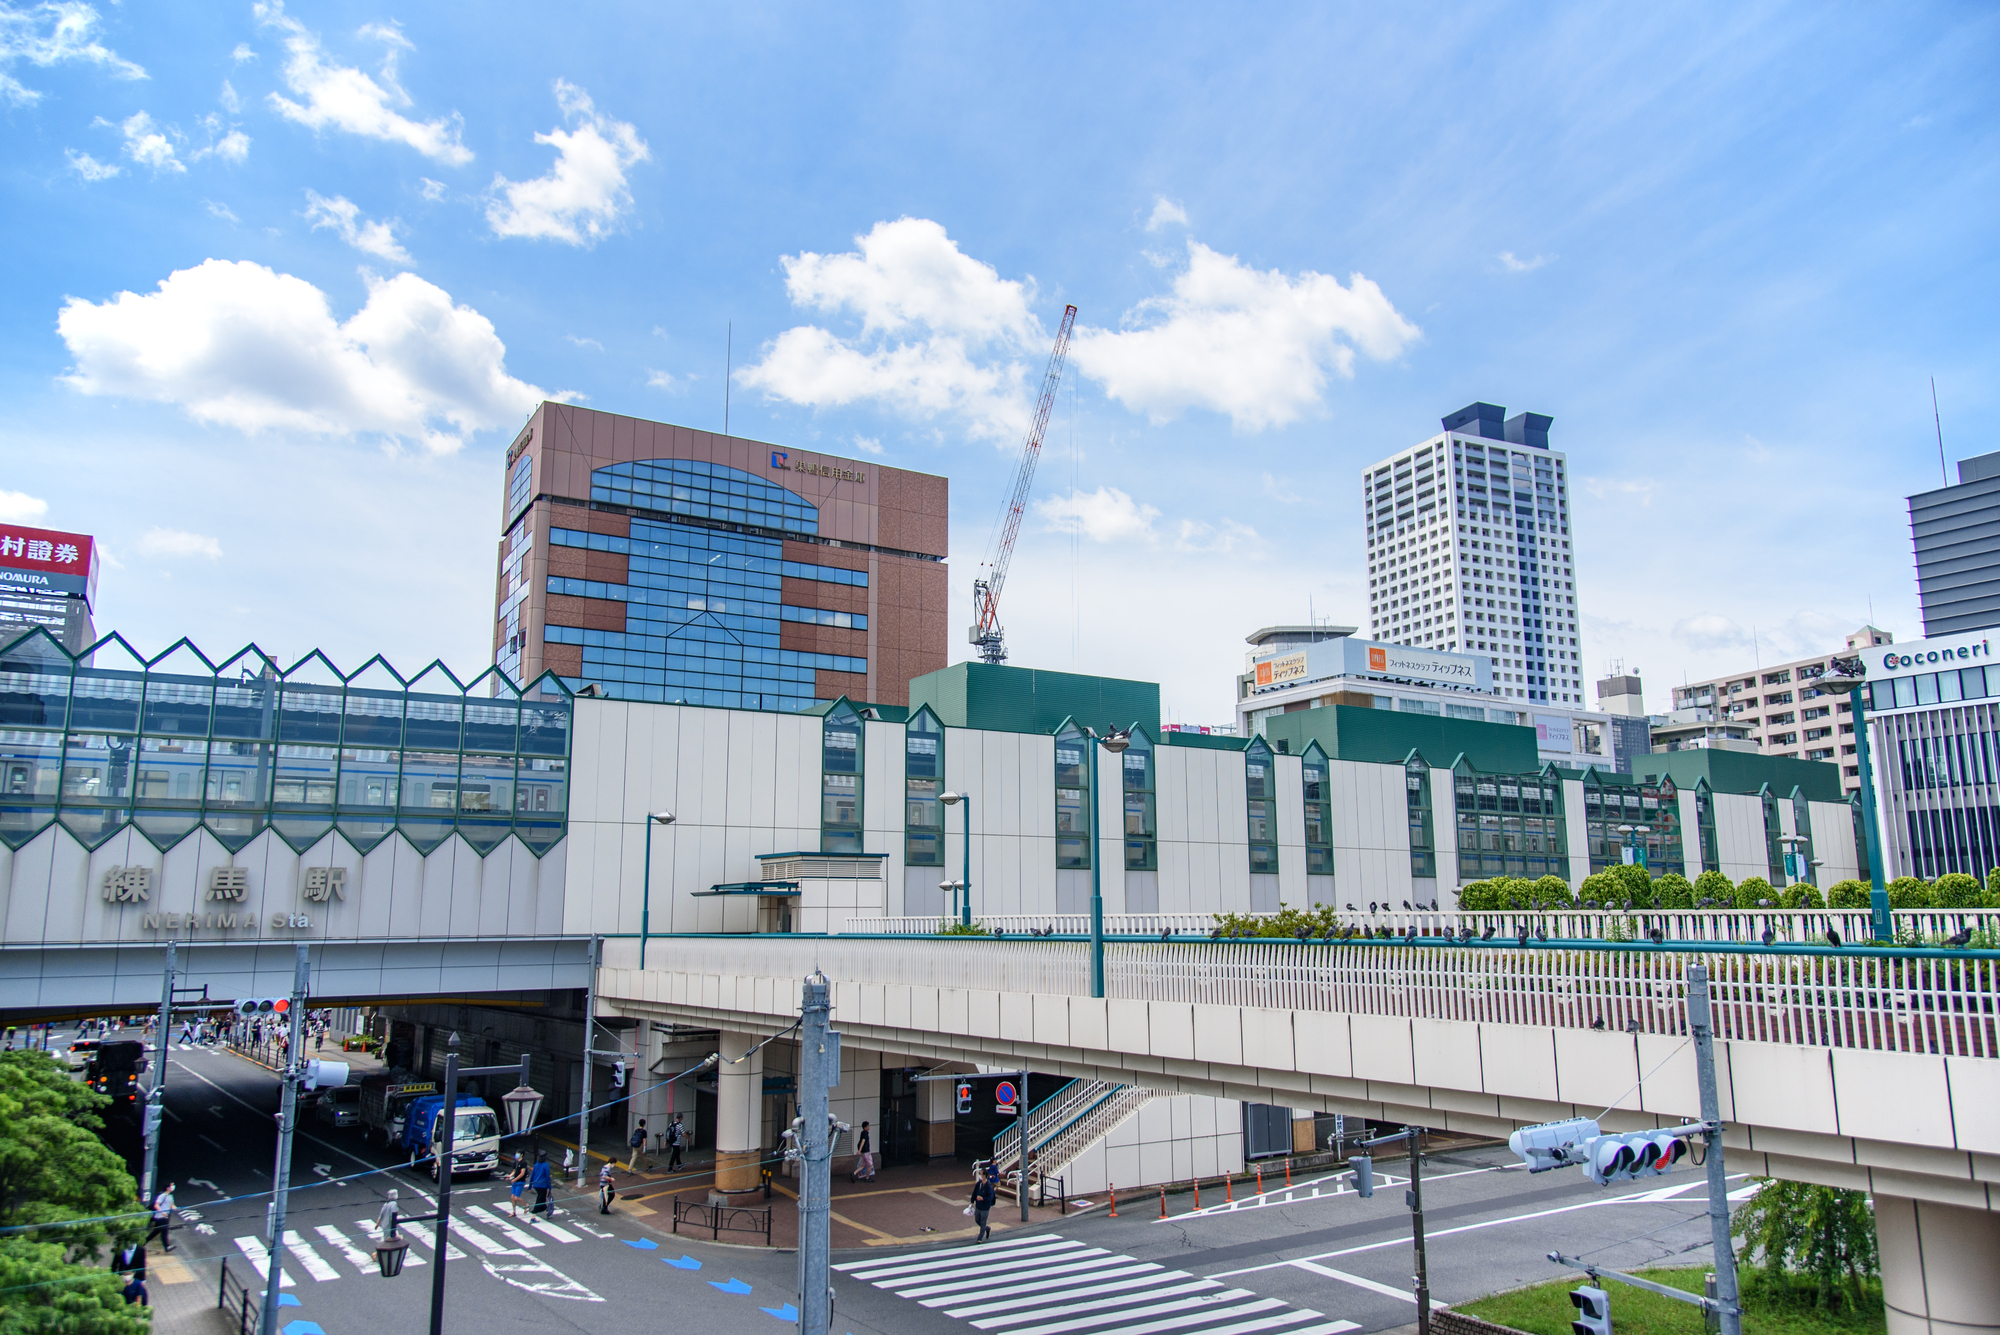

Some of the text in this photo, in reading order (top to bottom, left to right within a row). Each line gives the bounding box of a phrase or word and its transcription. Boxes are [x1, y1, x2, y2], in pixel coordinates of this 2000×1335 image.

[0, 535, 79, 564] 村證券
[1883, 639, 1989, 670] Coconeri
[1432, 661, 1472, 678] ティップネス
[102, 864, 347, 903] 練馬駅
[143, 911, 314, 930] NERIMA Sta.
